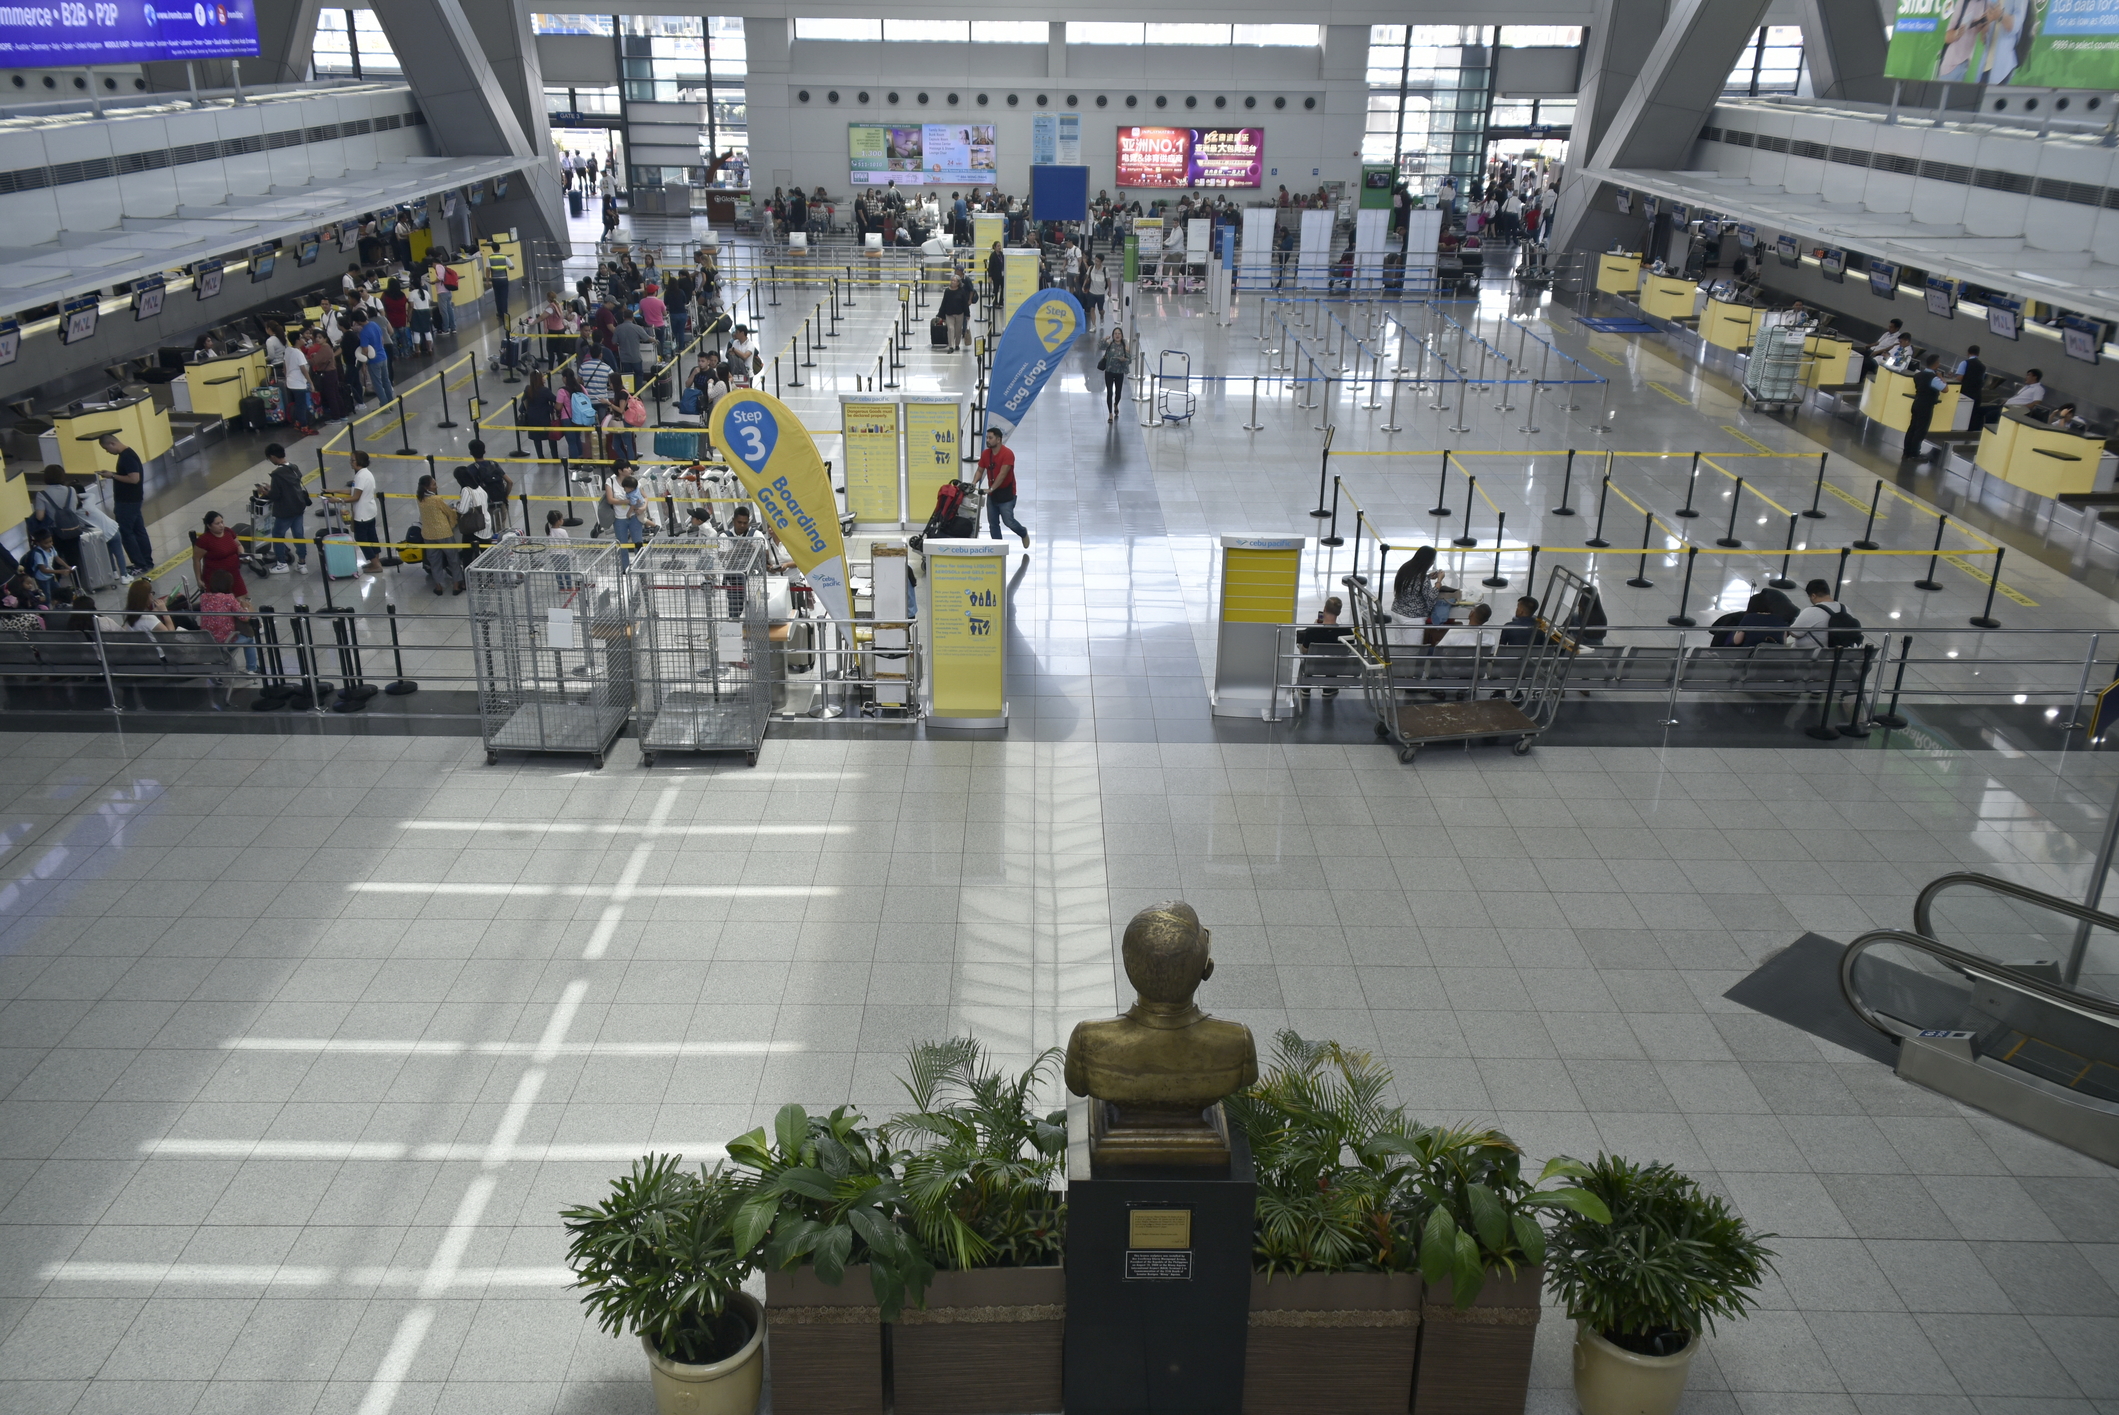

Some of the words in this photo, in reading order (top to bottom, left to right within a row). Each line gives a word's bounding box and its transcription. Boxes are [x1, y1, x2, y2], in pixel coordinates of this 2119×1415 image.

[60, 2, 88, 27] B2B
[94, 2, 119, 27] P2P
[560, 112, 575, 120] GATE
[143, 295, 158, 311] MNL
[1046, 305, 1066, 318] Step
[72, 316, 90, 334] MNL
[1043, 318, 1064, 344] 2
[1993, 313, 2010, 331] MNL
[2070, 335, 2089, 354] MNL
[1003, 362, 1030, 397] INTERNATIONAL
[1004, 387, 1030, 412] Bag
[1024, 358, 1047, 386] drop
[733, 410, 763, 424] Step
[739, 425, 766, 462] 3
[758, 487, 790, 530] Gate
[771, 474, 828, 554] Boarding
[970, 546, 994, 555] pacific
[1267, 540, 1292, 548] pacific
[822, 580, 841, 588] pacific
